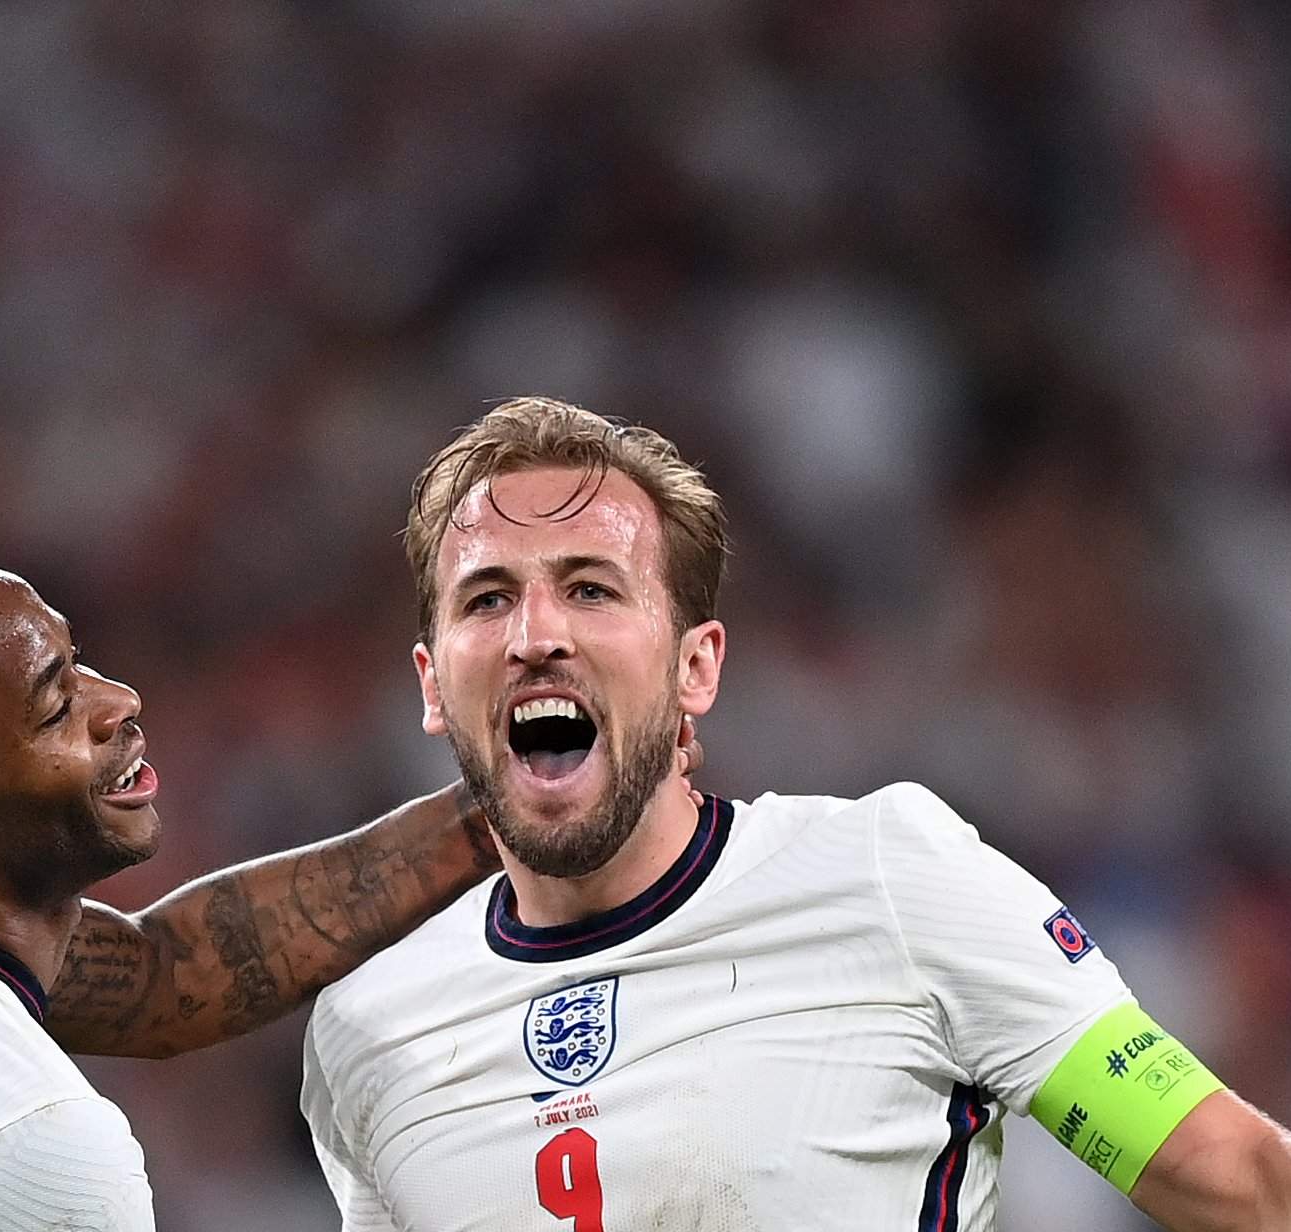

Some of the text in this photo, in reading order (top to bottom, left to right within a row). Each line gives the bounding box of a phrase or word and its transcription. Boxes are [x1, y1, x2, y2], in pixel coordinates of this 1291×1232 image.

[533, 1104, 599, 1128] 7 JULY 2021
